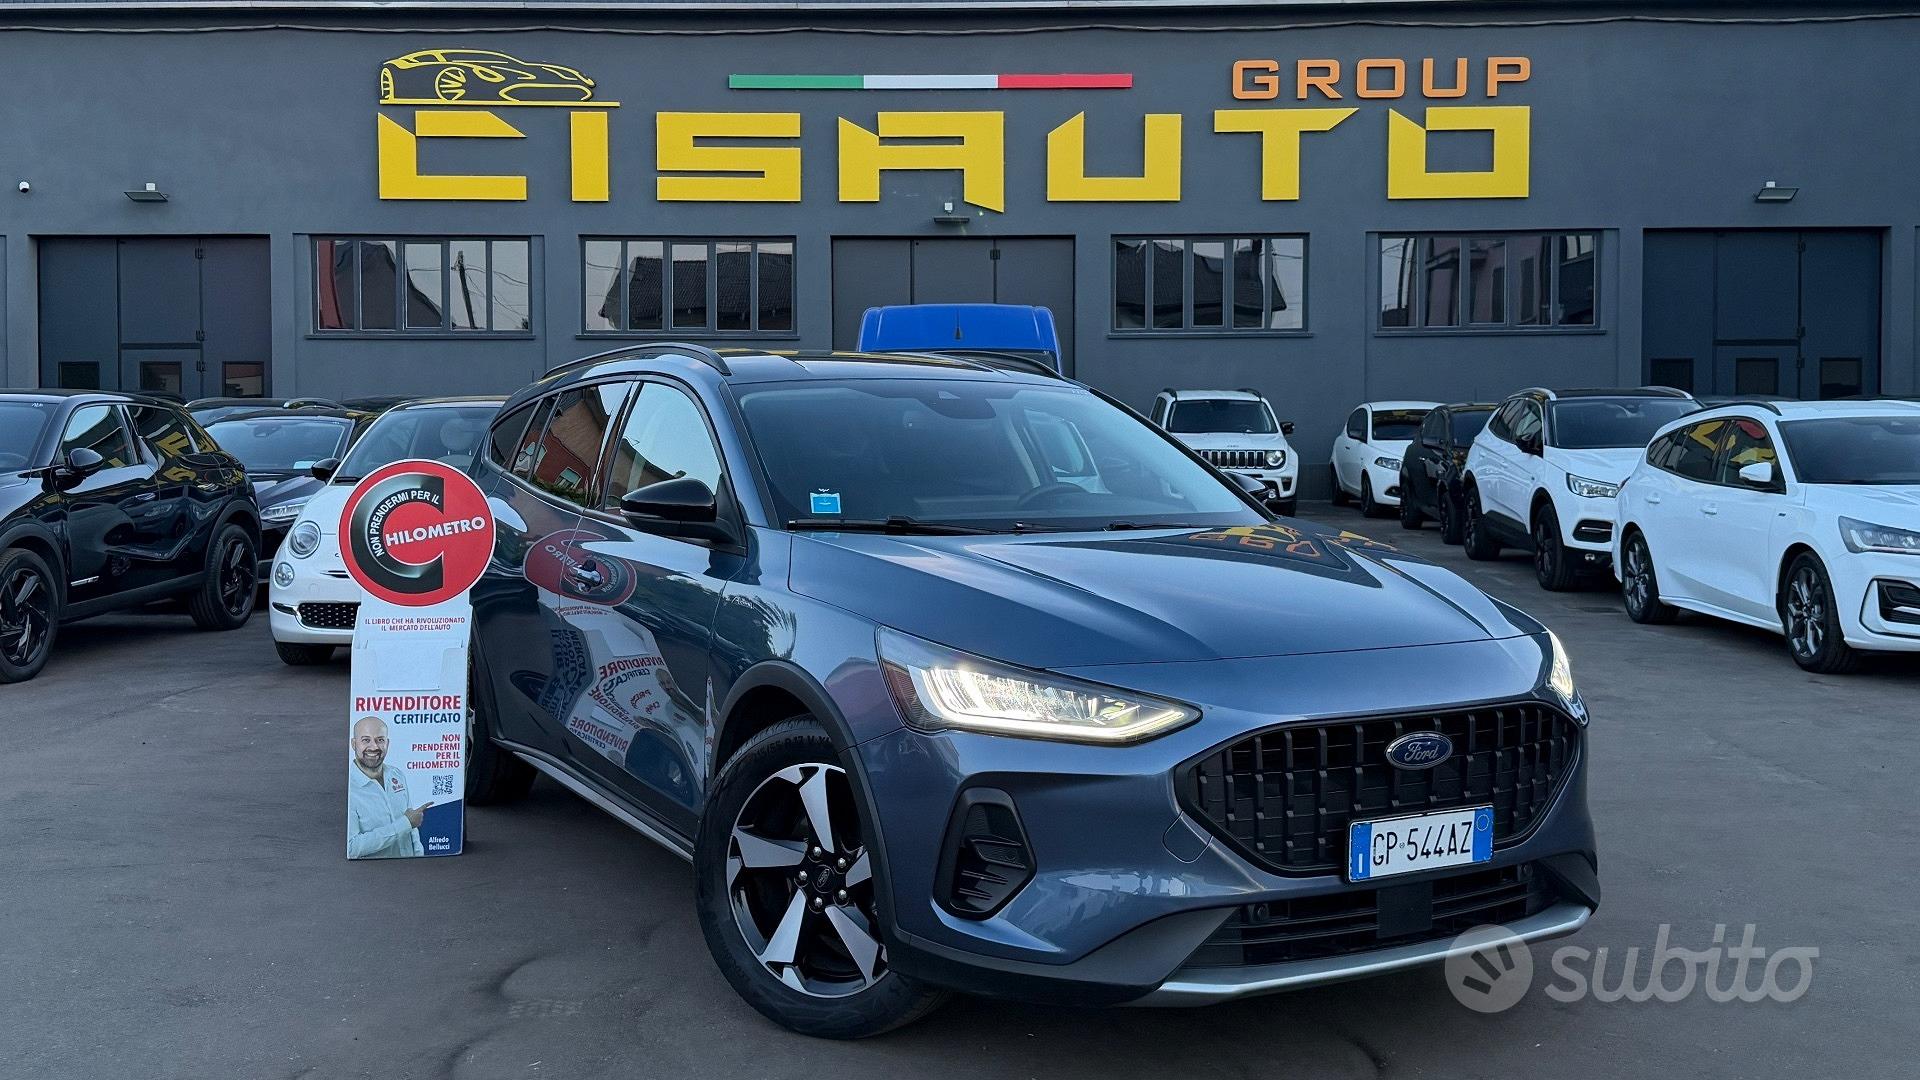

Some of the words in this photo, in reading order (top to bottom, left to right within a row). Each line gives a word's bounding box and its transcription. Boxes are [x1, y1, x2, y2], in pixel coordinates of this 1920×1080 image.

[1232, 56, 1531, 100] GROUP
[377, 105, 1531, 213] CISAUTO
[410, 490, 430, 500] PER
[431, 495, 440, 505] IL
[369, 491, 409, 535] PRENDERMI
[370, 535, 385, 558] NON
[389, 624, 418, 632] MERCATO
[355, 695, 462, 712] RIVENDITORE
[393, 712, 462, 725] CERTIFICATO
[441, 734, 461, 742] NON
[411, 742, 461, 752] PRENDERMI
[1405, 742, 1438, 762] Ford
[435, 751, 451, 760] PER
[453, 751, 460, 760] IL
[406, 760, 460, 770] CHILOMETRO
[428, 836, 450, 844] Alfredo
[1373, 832, 1398, 866] GP
[1407, 822, 1473, 861] 544AZ
